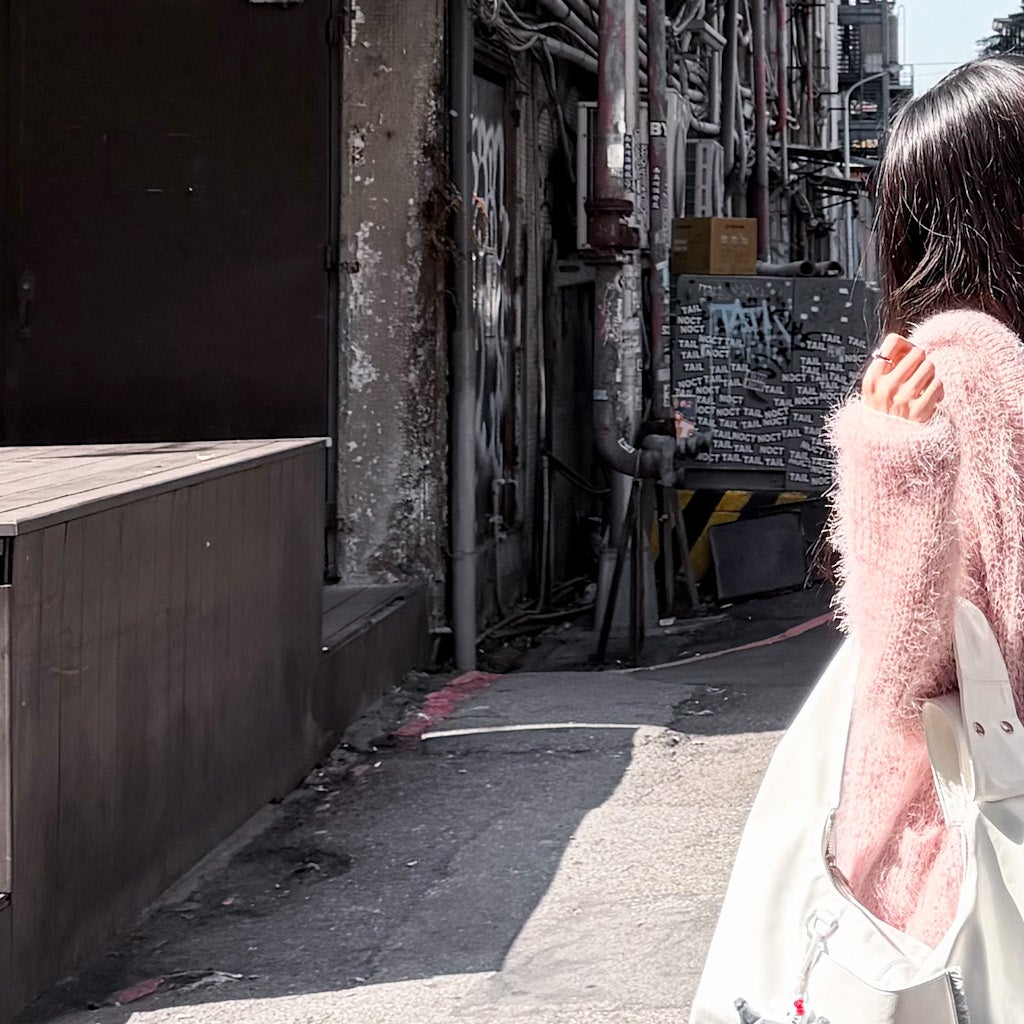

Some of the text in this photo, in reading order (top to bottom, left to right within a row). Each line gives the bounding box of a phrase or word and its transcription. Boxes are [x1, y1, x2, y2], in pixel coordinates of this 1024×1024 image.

[681, 305, 702, 315] TAIL
[677, 316, 702, 325] NOCT
[680, 325, 705, 333] NOCT
[698, 334, 723, 345] NOCT
[822, 333, 842, 344] TAIL
[679, 340, 699, 349] TAIL
[806, 340, 827, 351] TAIL
[681, 351, 701, 360] TAIL
[706, 349, 730, 358] NOCT
[844, 354, 867, 362] NOC
[800, 356, 821, 366] TAIL
[684, 363, 704, 371] TAIL
[710, 365, 730, 374] TAIL
[823, 362, 845, 372] TAIL
[704, 375, 723, 383] TAIL
[781, 373, 806, 382] NOCT
[678, 377, 703, 388] NOCT
[723, 379, 743, 387] TAIL
[695, 386, 720, 394] NOCT
[764, 385, 784, 395] TAIL
[797, 386, 818, 395] TAIL
[719, 394, 744, 404] NOCT
[774, 398, 794, 408] TAIL
[794, 396, 820, 405] NOCT
[716, 407, 741, 416] NOCT
[743, 407, 763, 418] TAIL
[764, 407, 789, 419] NOCT
[697, 416, 717, 427] TAIL
[762, 417, 788, 426] NOCT
[792, 413, 813, 424] TAIL
[719, 419, 738, 429] TAIL
[741, 420, 762, 429] TAIL
[713, 429, 733, 439] TAIL
[732, 431, 757, 442] NOCT
[757, 433, 782, 443] NOCT
[781, 429, 802, 438] TAIL
[713, 440, 733, 449] TAIL
[733, 444, 753, 453] TAIL
[759, 446, 785, 455] NOCT
[721, 453, 742, 462] TAIL
[742, 455, 764, 465] TAIL
[764, 458, 785, 467] TAIL
[810, 466, 831, 475] NOC
[789, 473, 810, 483] TAIL
[811, 476, 831, 486] NOC
